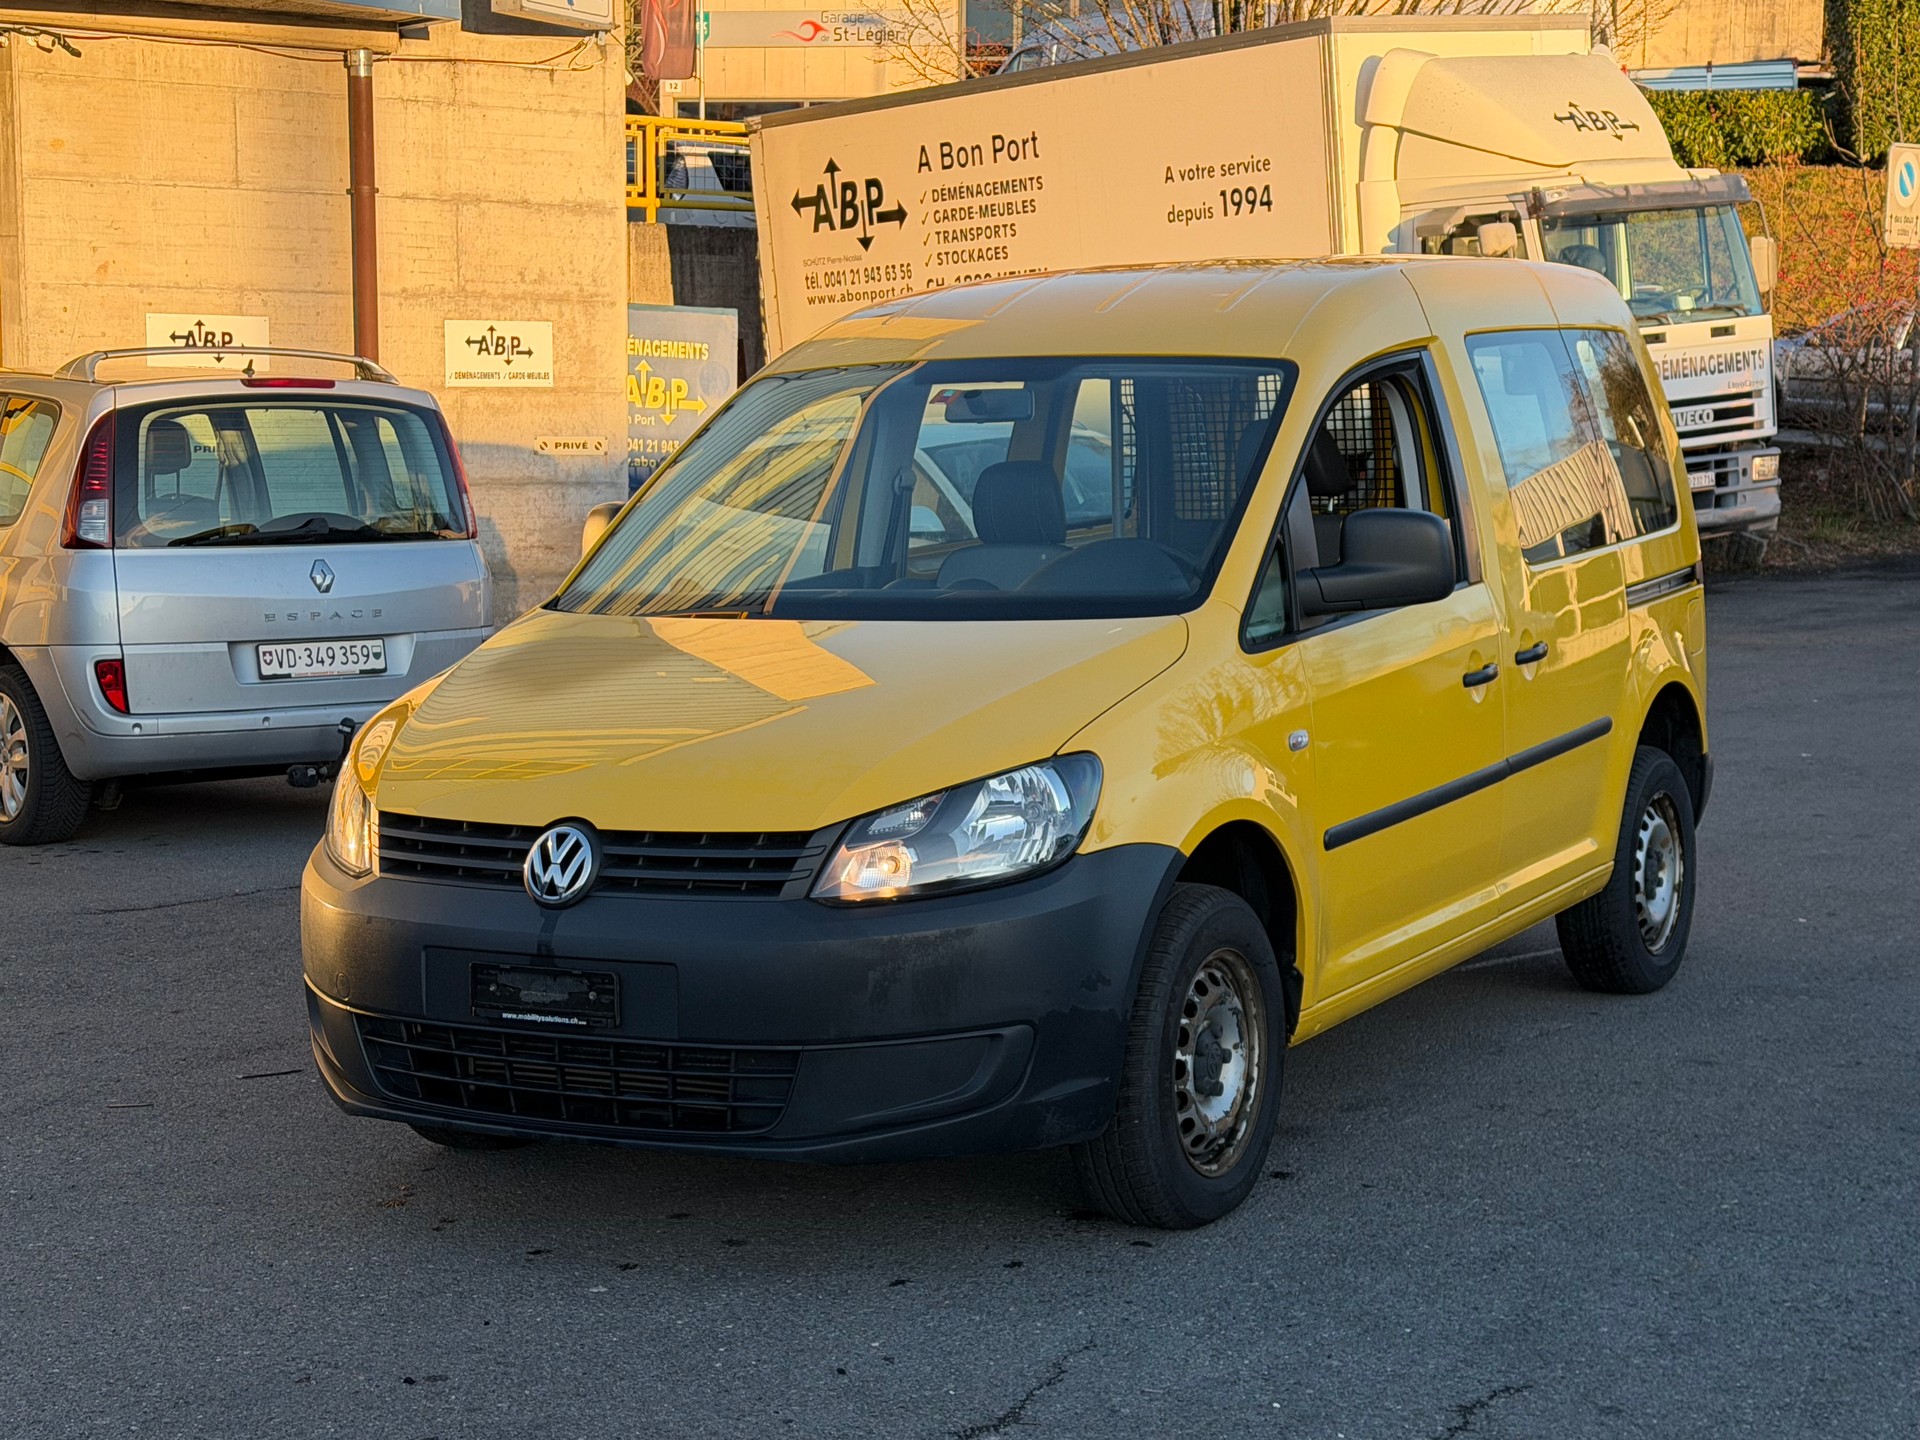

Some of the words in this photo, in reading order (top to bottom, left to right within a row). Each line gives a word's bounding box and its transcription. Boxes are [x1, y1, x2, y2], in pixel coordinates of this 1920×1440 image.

[821, 10, 865, 26] Garage
[833, 27, 900, 45] St-Légier
[1568, 110, 1620, 132] ABP
[917, 144, 933, 174] A
[940, 141, 984, 171] Bon
[991, 131, 1041, 164] Port
[1164, 165, 1175, 184] A
[1178, 164, 1216, 182] votre
[1220, 154, 1271, 177] service
[931, 176, 1044, 203] DÉMÉNAGEMENTS
[812, 177, 884, 234] ABP
[933, 199, 1037, 225] GARDE-MEUBLES
[1167, 201, 1214, 227] depuis
[1219, 184, 1273, 217] 1994
[934, 223, 1017, 245] TRANSPORTS
[936, 246, 1009, 267] STOCKAGES
[804, 271, 823, 290] tél.
[823, 269, 848, 288] 0041
[849, 267, 861, 286] 21
[863, 266, 882, 284] 943
[884, 264, 898, 282] 63
[900, 262, 913, 280] 56
[807, 283, 914, 305] www.abonport.ch
[476, 335, 521, 356] ABP
[627, 334, 709, 361] ÉNAGEMENTS
[1654, 348, 1765, 381] DÉMÉNAGEMENTS
[627, 374, 689, 410] ABP
[634, 414, 656, 426] Port
[1672, 408, 1714, 427] IVECO
[554, 440, 589, 450] PRIVÉ
[646, 439, 658, 453] 21
[264, 609, 383, 623] ESPACE
[502, 1012, 578, 1025] www.mobilitysolutions.ch
